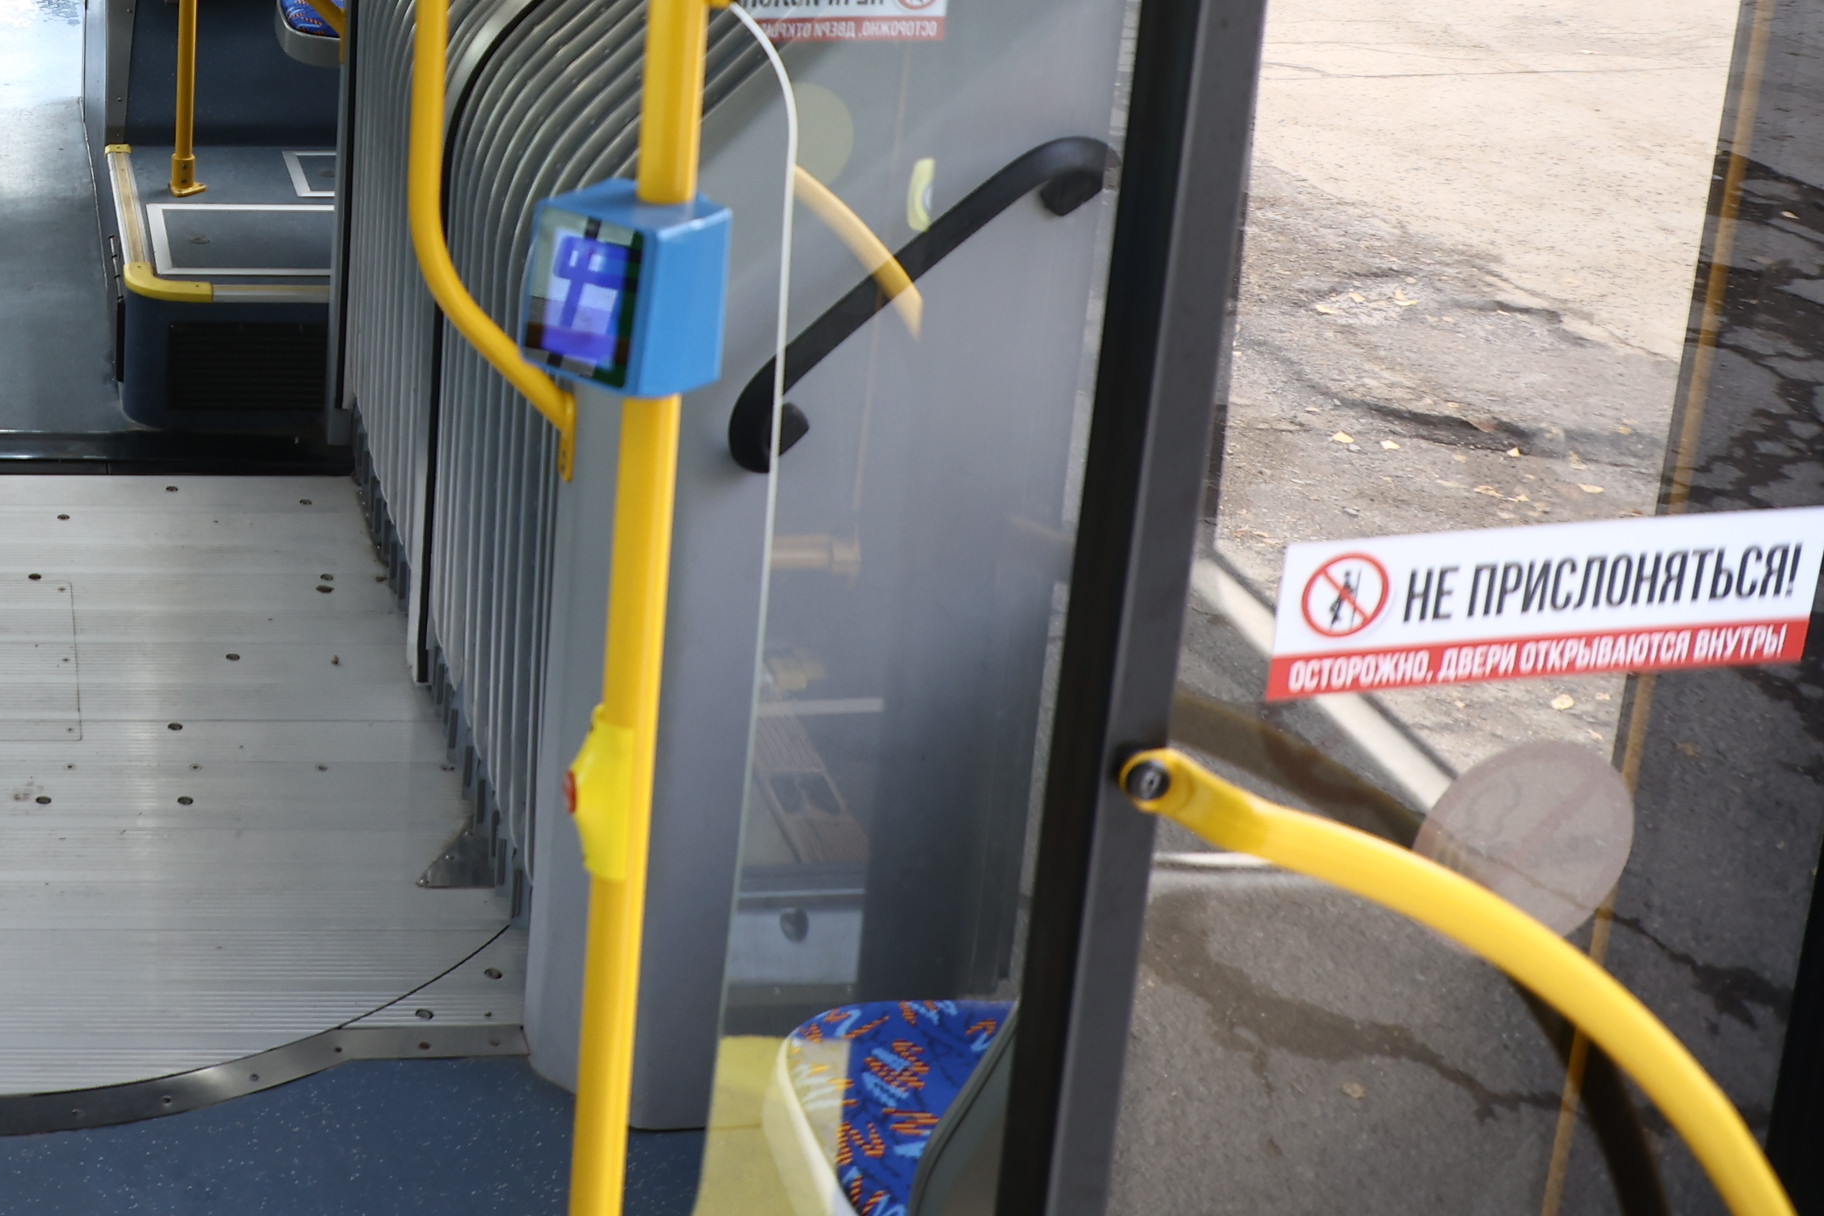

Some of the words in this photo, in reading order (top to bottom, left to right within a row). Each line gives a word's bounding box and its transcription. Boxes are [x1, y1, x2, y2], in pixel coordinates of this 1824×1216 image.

[1402, 566, 1460, 623] НЕ
[1466, 542, 1804, 618] ПРИСЛОНЯТЬСЯ!
[1288, 649, 1434, 693] ОСТОРОЖНО,
[1437, 641, 1519, 683] ДВЕРИ
[1519, 630, 1692, 674] ОТКРЫВАЮТСЯ
